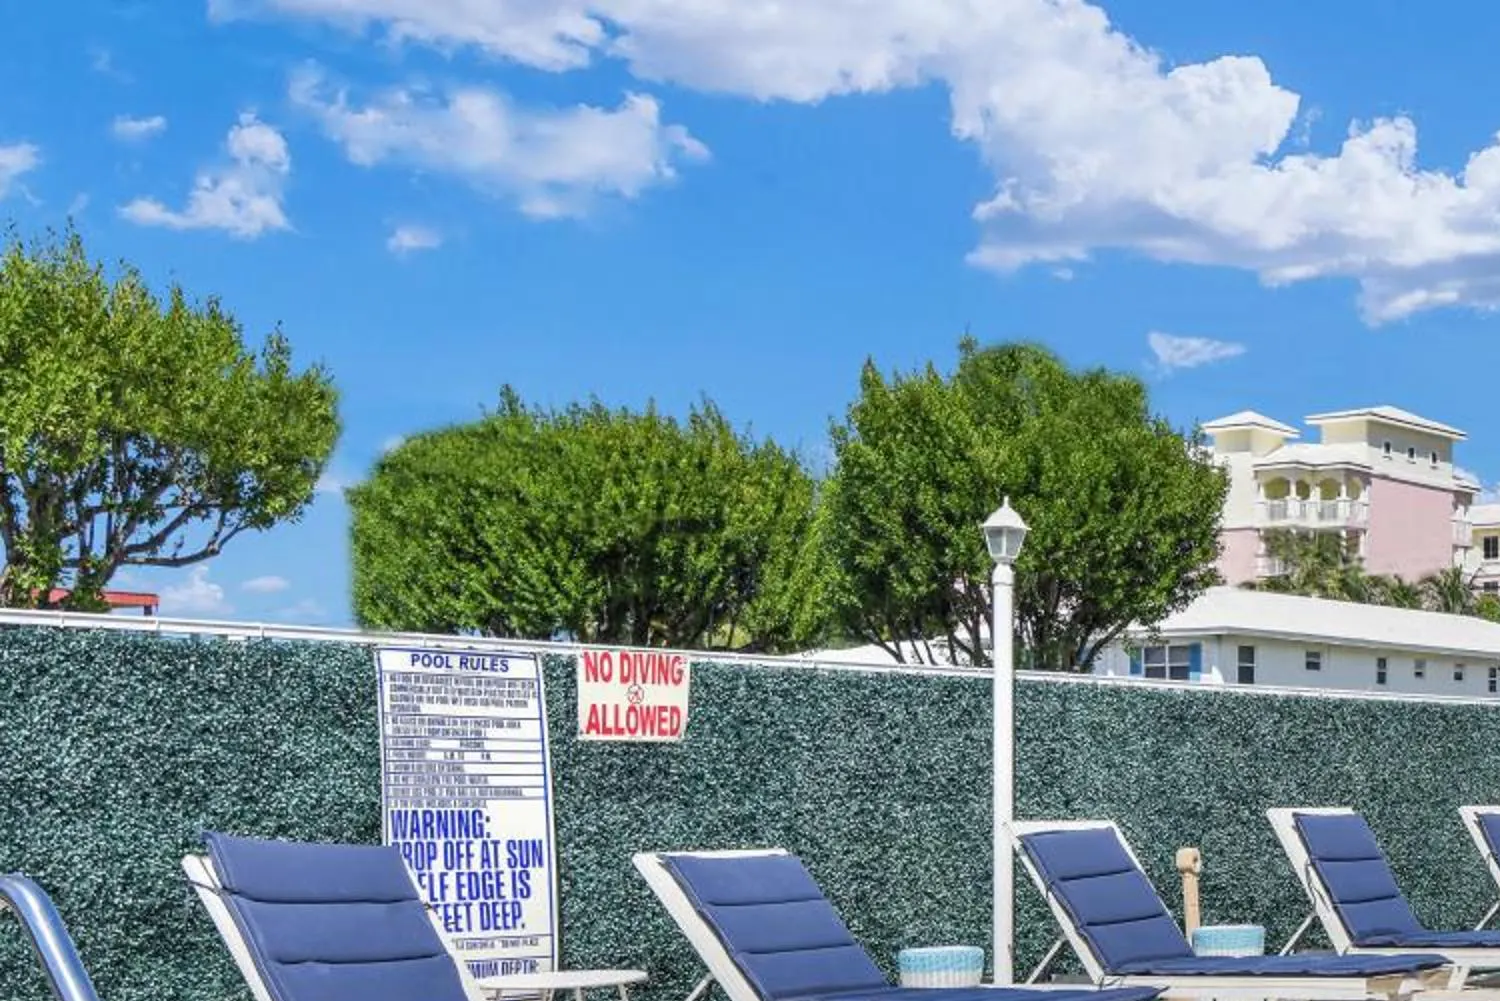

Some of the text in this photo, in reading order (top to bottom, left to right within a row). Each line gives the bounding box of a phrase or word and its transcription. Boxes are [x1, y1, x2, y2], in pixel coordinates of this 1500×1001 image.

[411, 653, 510, 673] POOL RULES
[583, 650, 685, 686] NO DIVING
[585, 703, 681, 737] ALLOWED
[390, 809, 491, 840] WARNING:
[391, 839, 545, 871] ROP OFF AT SUN
[455, 870, 505, 901] EDGE
[511, 869, 532, 899] IS
[479, 901, 526, 932] DEEP.
